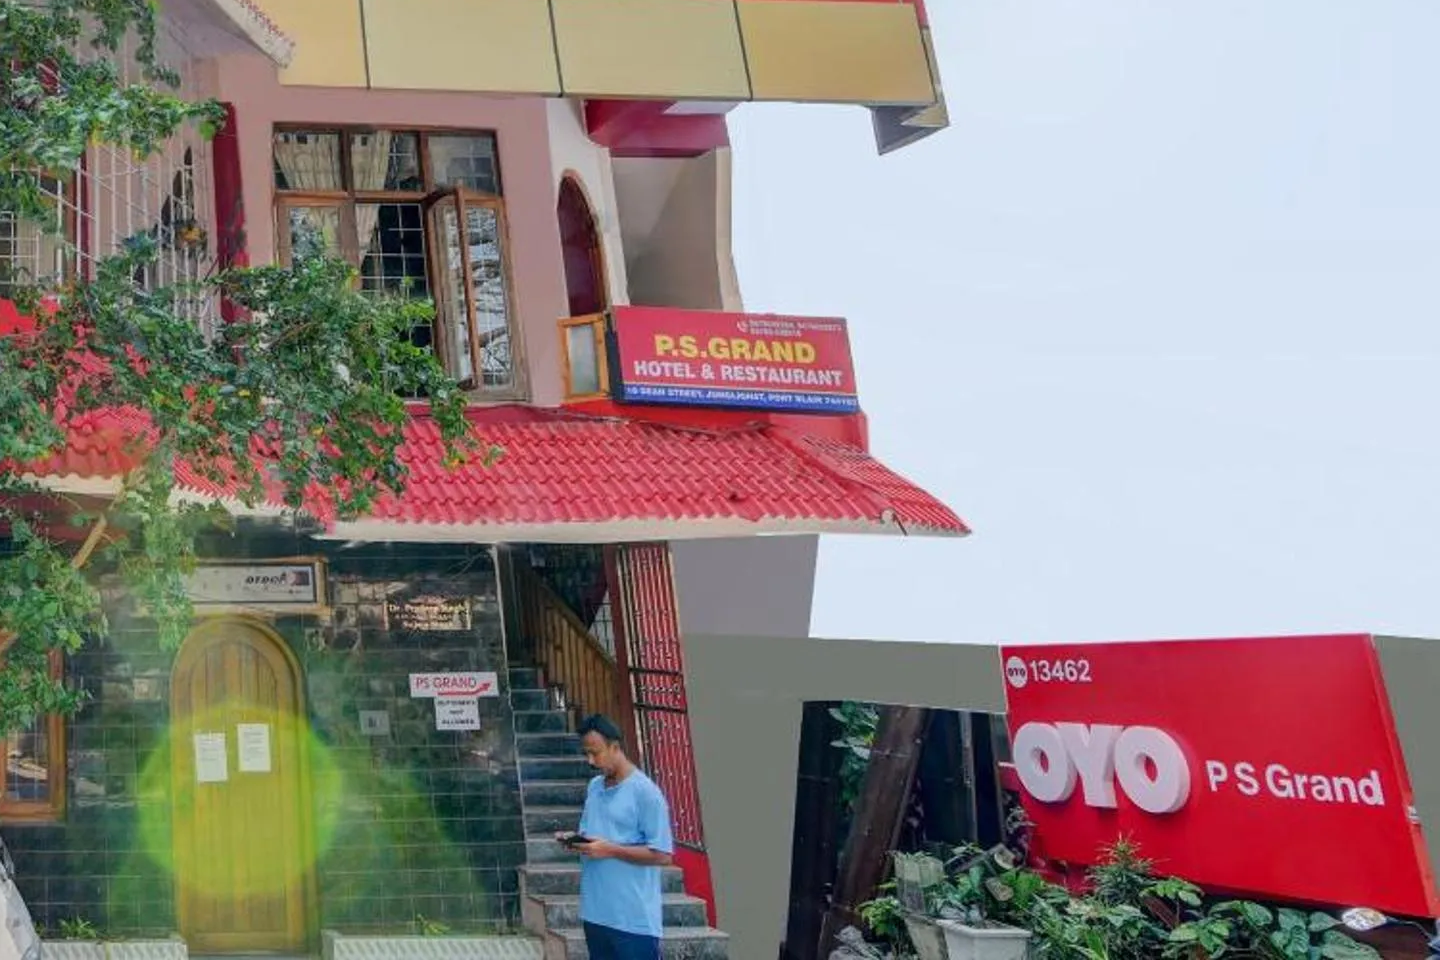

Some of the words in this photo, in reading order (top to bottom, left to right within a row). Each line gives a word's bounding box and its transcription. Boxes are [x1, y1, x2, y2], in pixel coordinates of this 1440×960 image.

[634, 361, 696, 379] HOTEL
[701, 363, 715, 380] &
[721, 365, 844, 386] RESTAURANT
[1030, 660, 1091, 681] 13462
[416, 676, 429, 689] PS
[432, 676, 477, 689] GRAND
[1013, 722, 1190, 813] OYO
[1206, 760, 1228, 792] P
[1236, 761, 1260, 796] S
[1266, 764, 1386, 807] Grand
